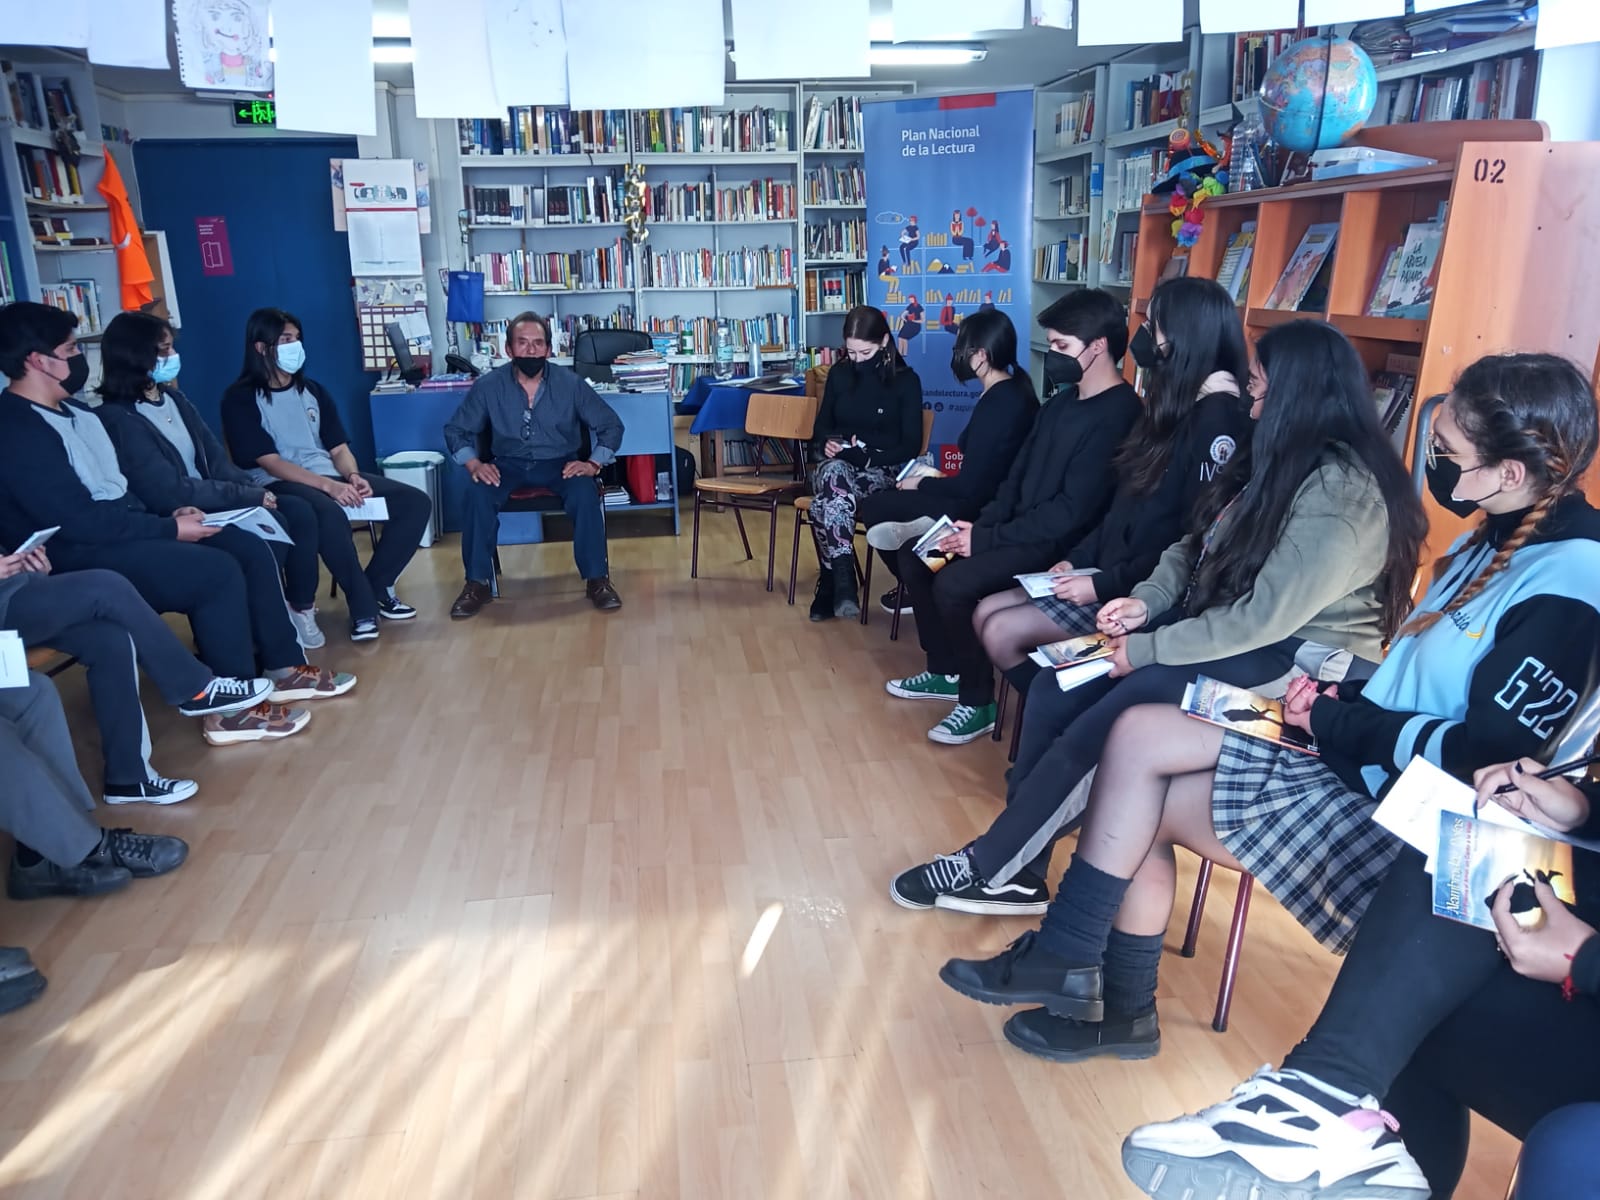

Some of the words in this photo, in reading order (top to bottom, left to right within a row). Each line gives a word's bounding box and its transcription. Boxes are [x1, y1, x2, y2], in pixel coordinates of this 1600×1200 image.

[901, 129, 927, 142] Plan
[929, 124, 979, 140] Nacional
[902, 144, 917, 157] de
[918, 144, 929, 156] la
[931, 143, 976, 155] Lectura
[1474, 158, 1506, 184] 02
[944, 451, 964, 460] Gob
[944, 461, 957, 470] de
